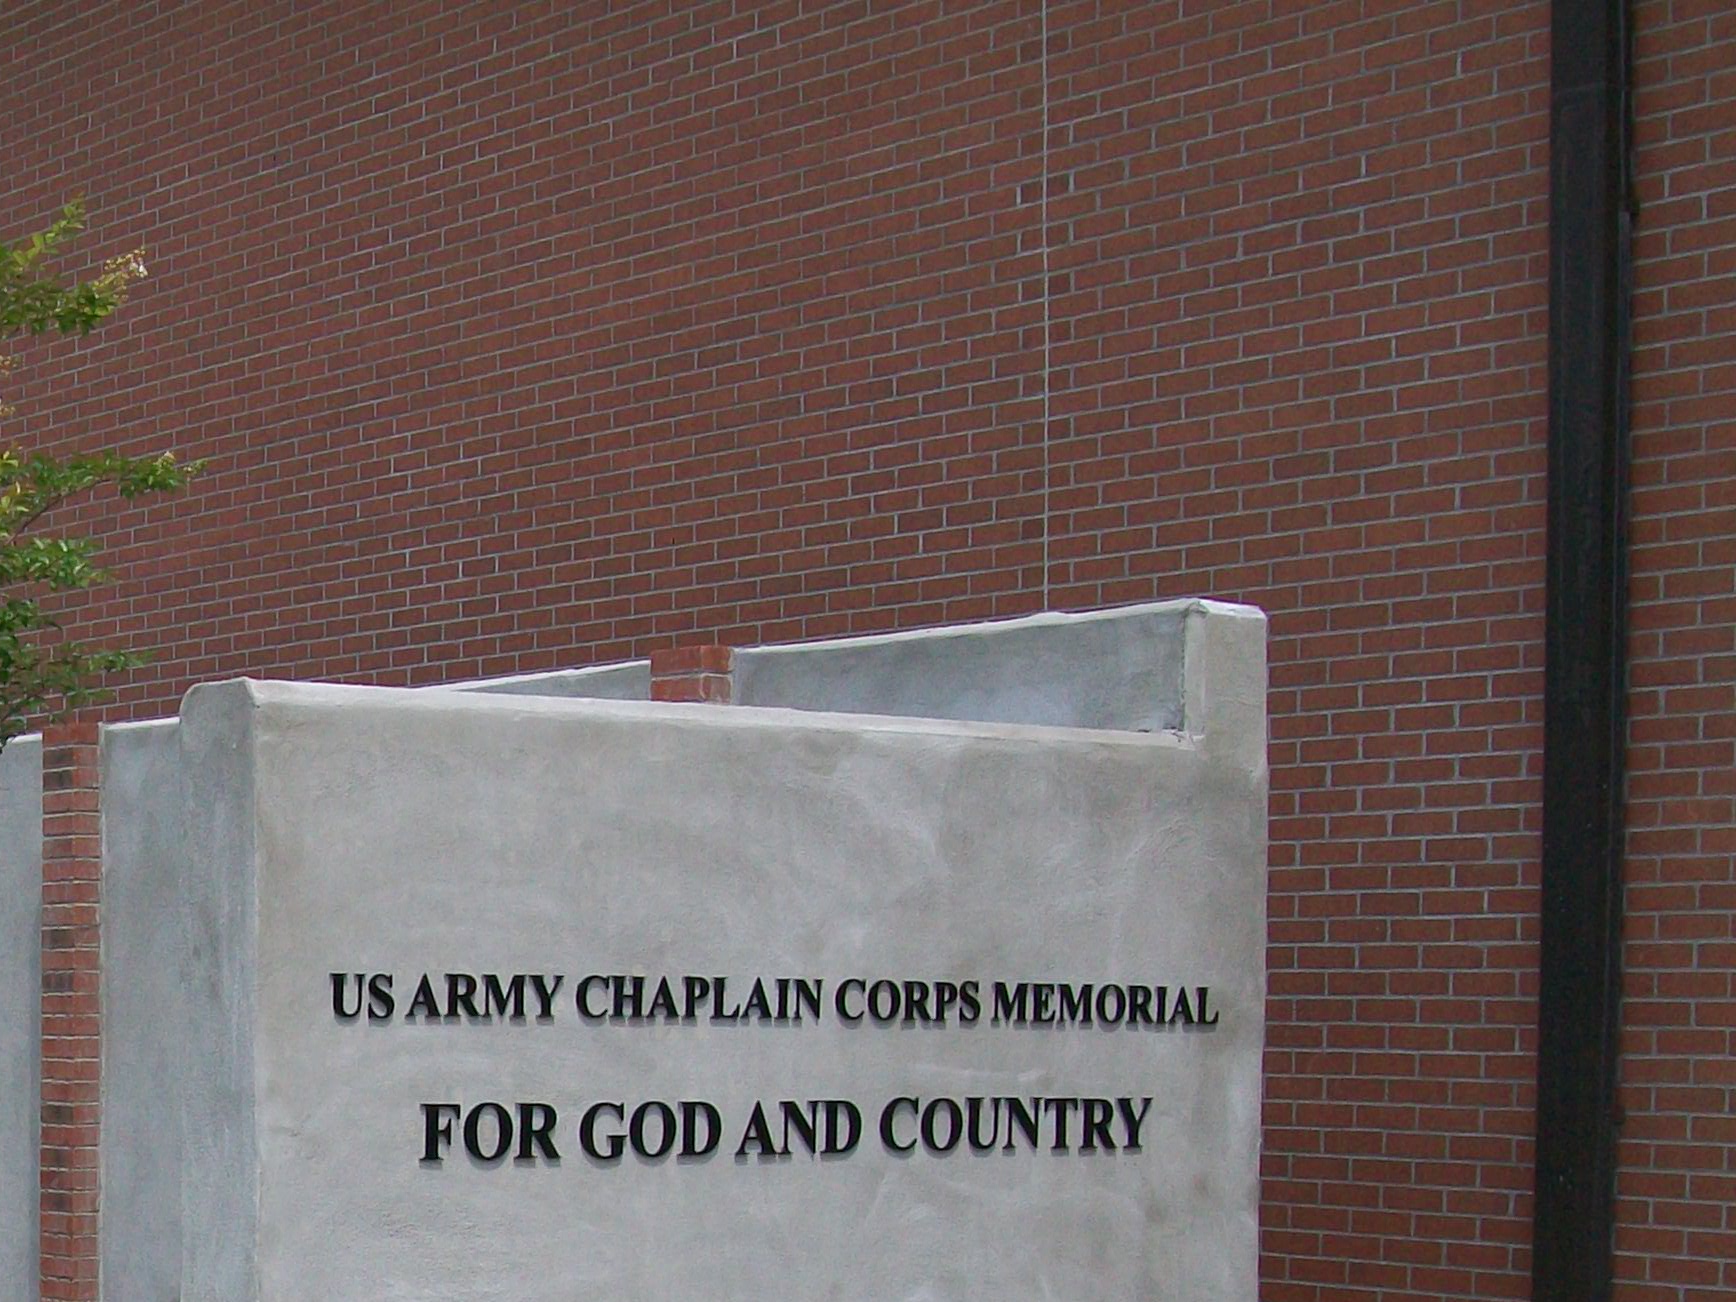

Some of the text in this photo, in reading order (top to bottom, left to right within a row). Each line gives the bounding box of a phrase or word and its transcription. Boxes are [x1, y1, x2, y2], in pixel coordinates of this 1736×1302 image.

[329, 972, 1220, 1026] US ARMY CHAPLAIN CORPS MEMORIAL
[419, 1096, 1153, 1163] FOR GOD AND COUNTRY
